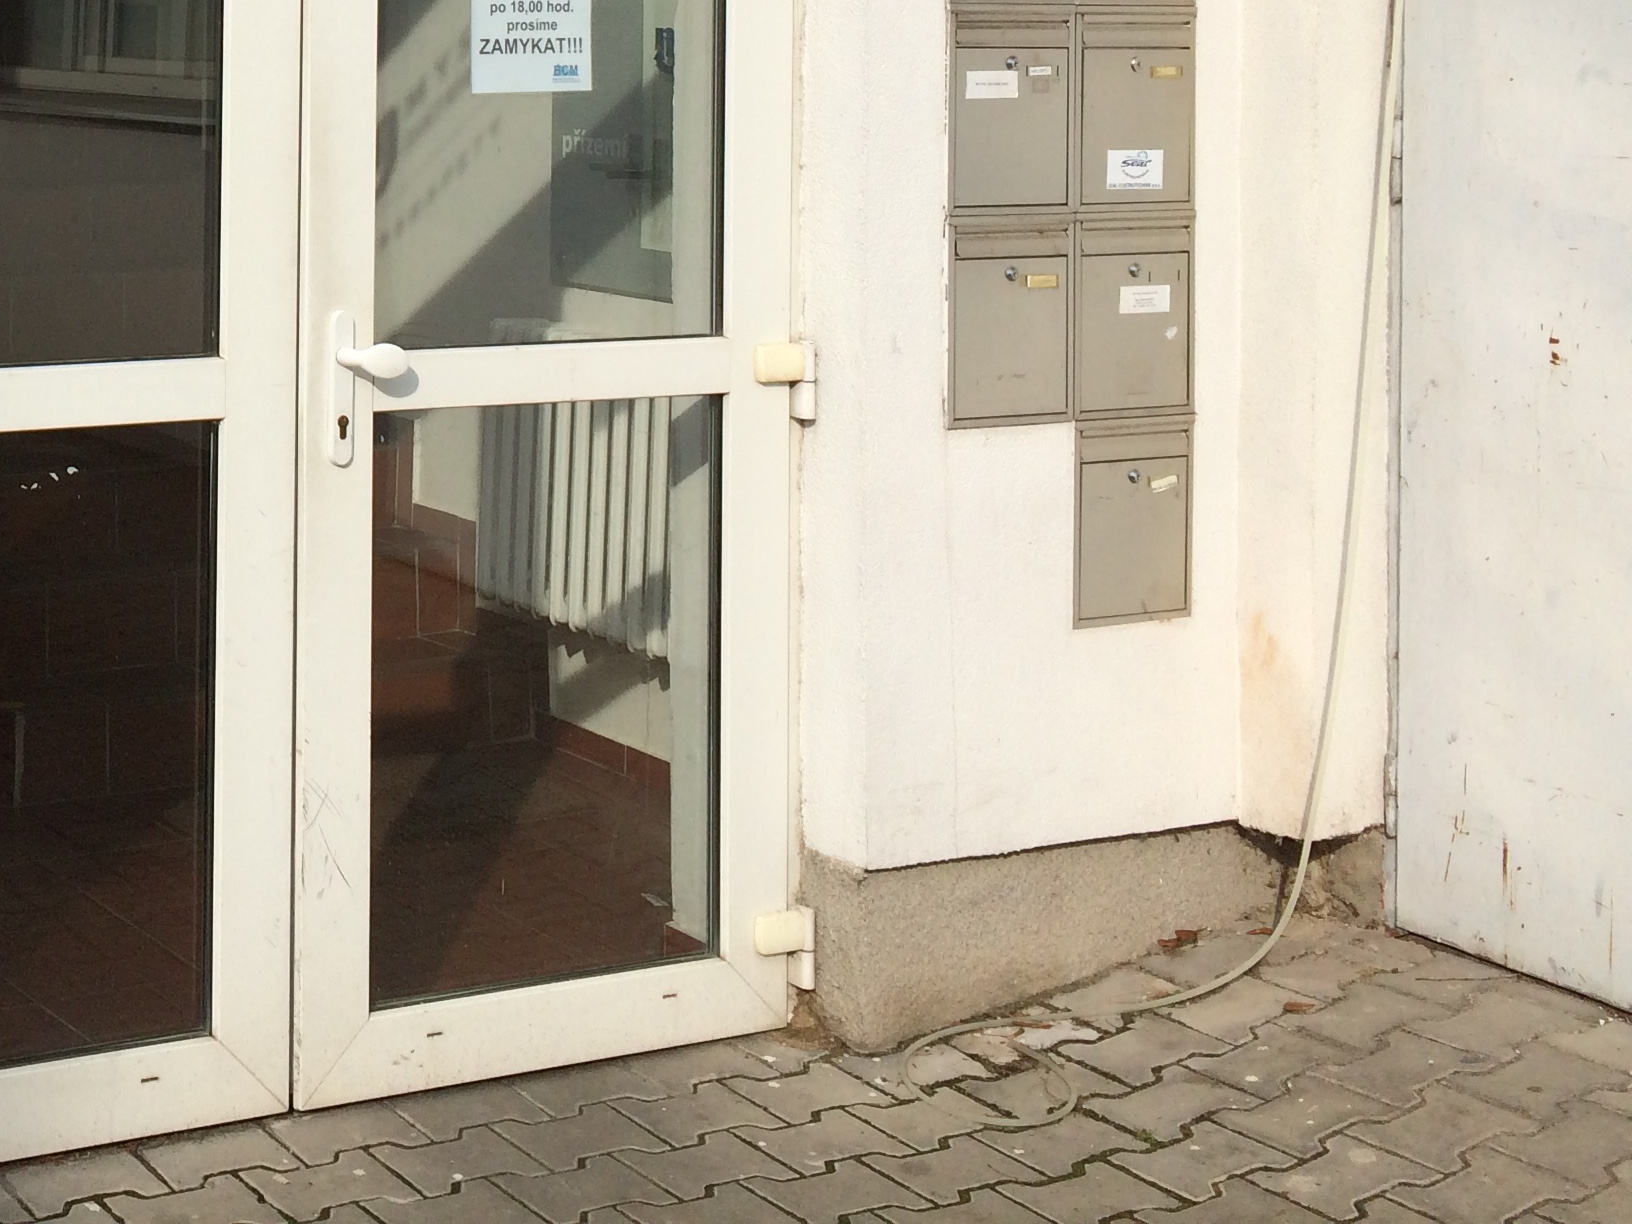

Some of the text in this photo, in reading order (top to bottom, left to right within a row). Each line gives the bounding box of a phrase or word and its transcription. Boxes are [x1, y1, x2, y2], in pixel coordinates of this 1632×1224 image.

[490, 0, 574, 16] po 18,00 hod.
[506, 18, 558, 34] prosíme
[478, 37, 583, 55] ZAMYKAT!!!
